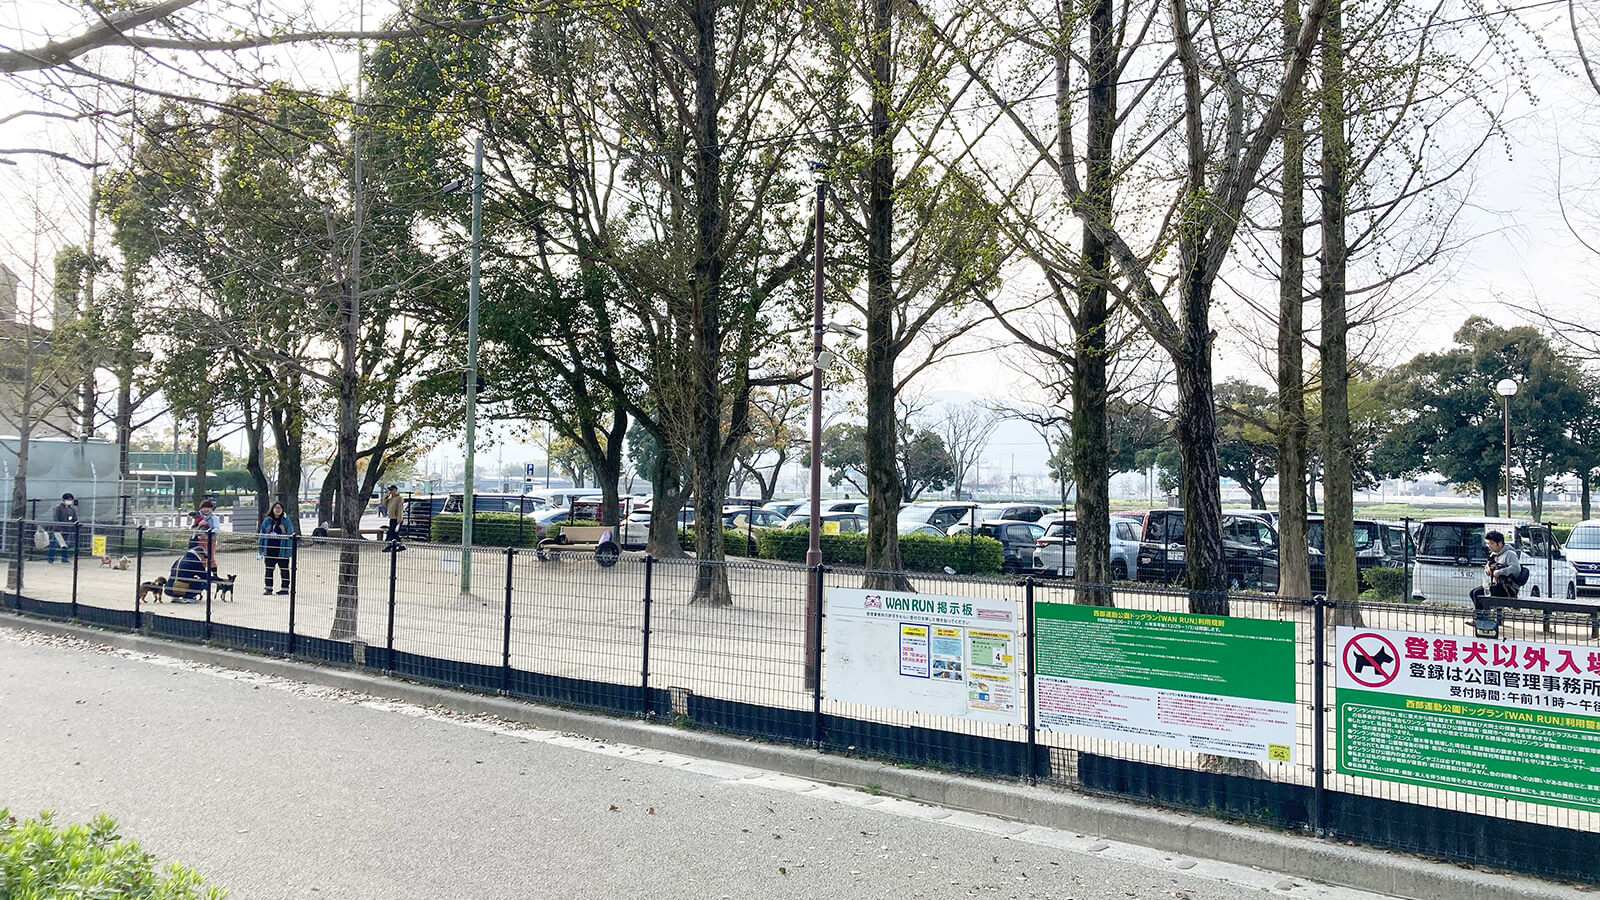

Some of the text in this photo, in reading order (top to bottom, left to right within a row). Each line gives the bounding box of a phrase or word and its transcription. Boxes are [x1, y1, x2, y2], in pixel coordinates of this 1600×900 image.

[886, 597, 910, 611] WAN
[913, 600, 934, 613] RUN
[937, 602, 973, 617] 掲示板
[1409, 663, 1600, 696] 登録は公園管理事務所
